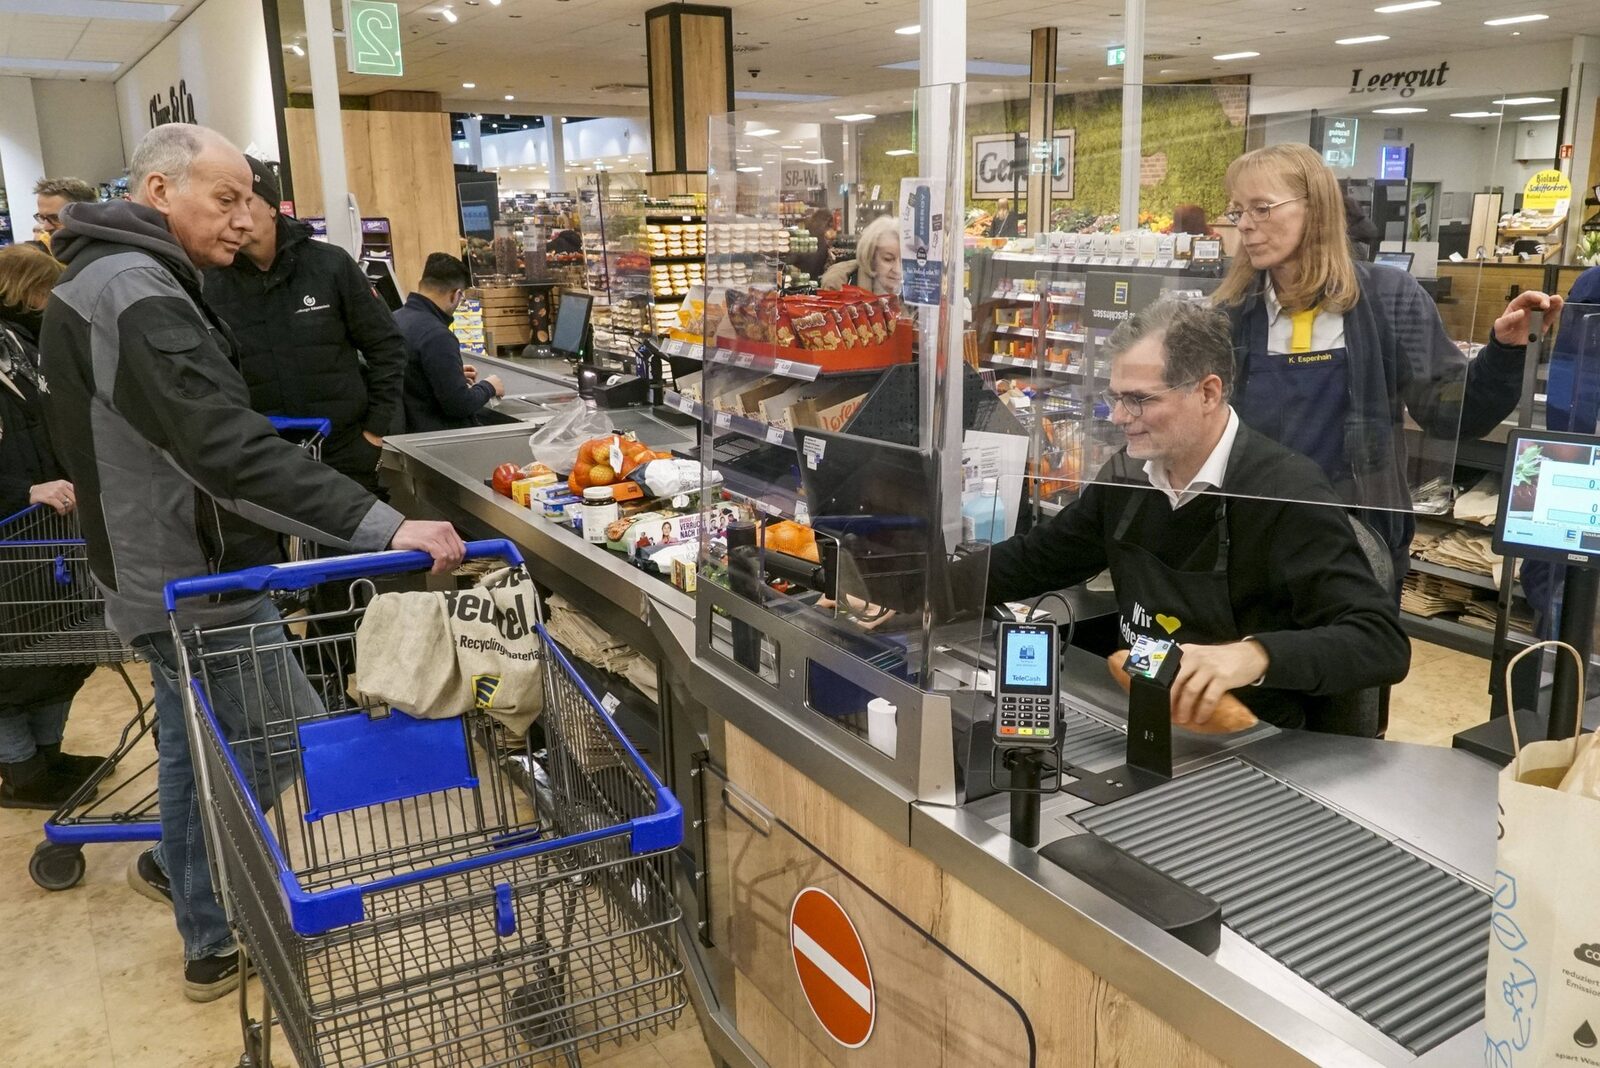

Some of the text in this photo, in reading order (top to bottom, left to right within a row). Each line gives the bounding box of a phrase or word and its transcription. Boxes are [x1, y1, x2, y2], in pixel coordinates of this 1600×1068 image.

[1348, 60, 1450, 99] Leergut
[1131, 601, 1153, 629] Wir
[1012, 674, 1042, 682] TeleCash
[1562, 968, 1600, 987] reduziert
[1555, 1052, 1579, 1062] spart
